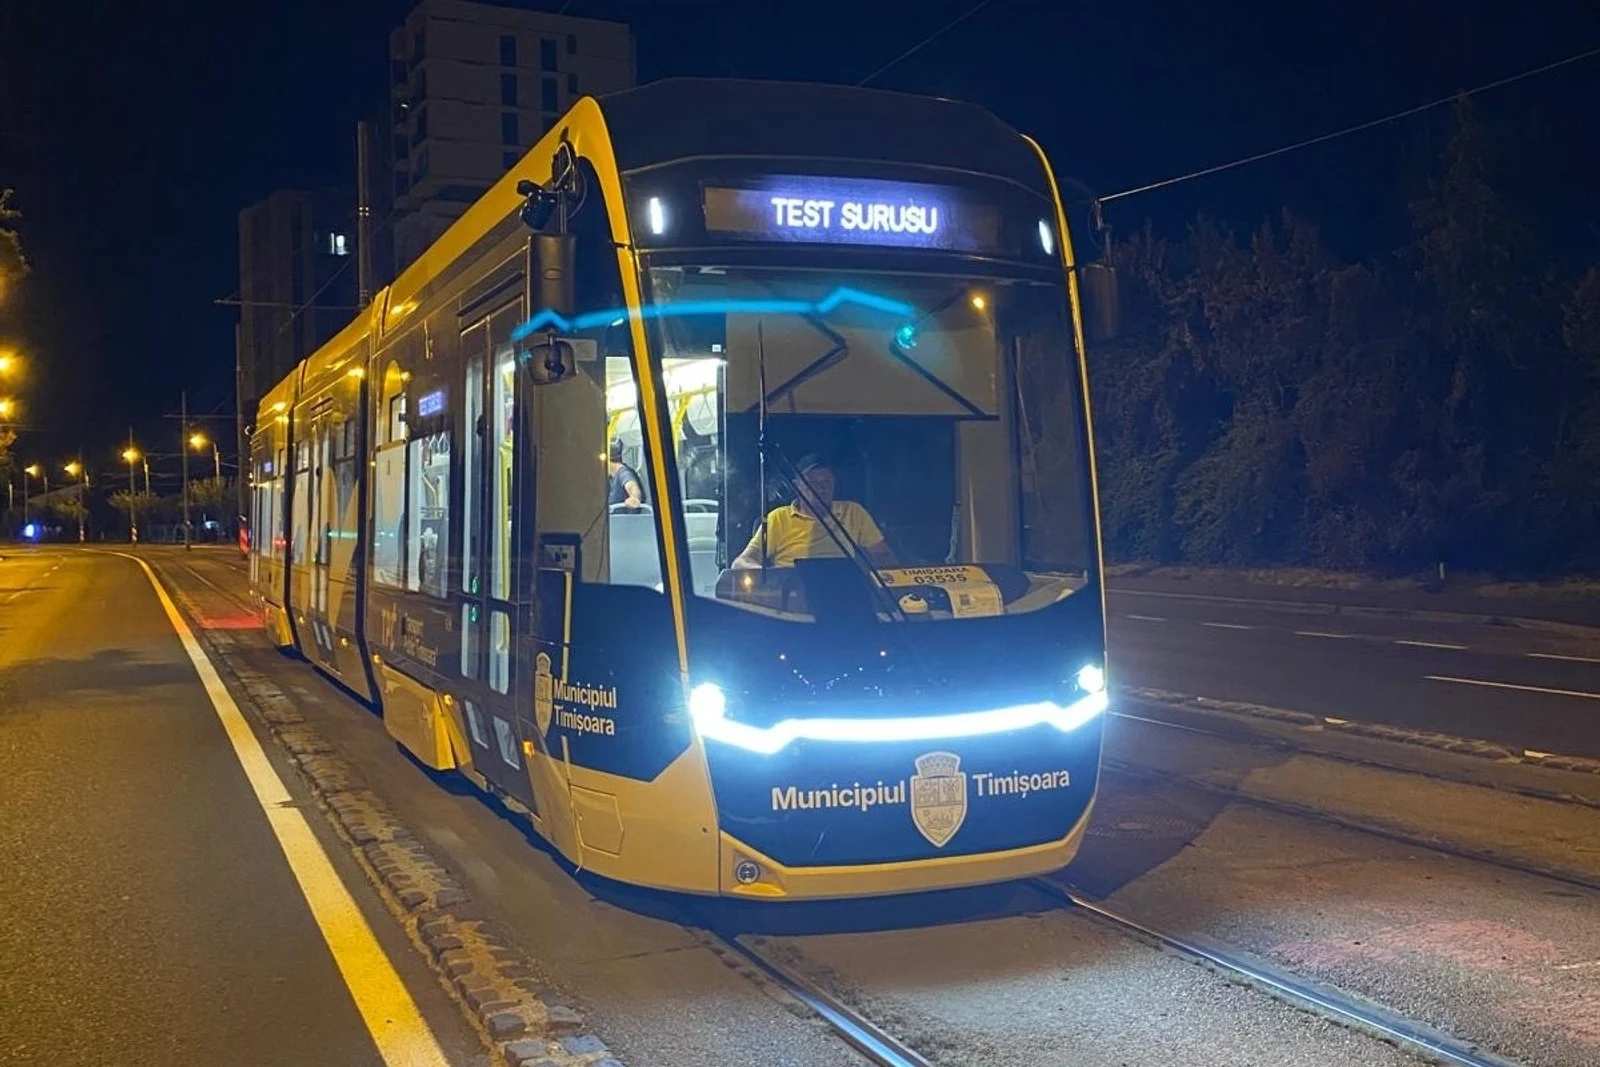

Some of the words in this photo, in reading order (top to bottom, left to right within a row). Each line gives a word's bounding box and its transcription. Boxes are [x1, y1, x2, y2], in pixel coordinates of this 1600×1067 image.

[771, 197, 835, 228] TEST
[840, 201, 938, 234] SURUSU
[553, 678, 617, 711] Municipiul
[553, 704, 615, 737] Timișoara
[771, 780, 906, 811] Municipiul
[971, 769, 1070, 799] Timișoara
